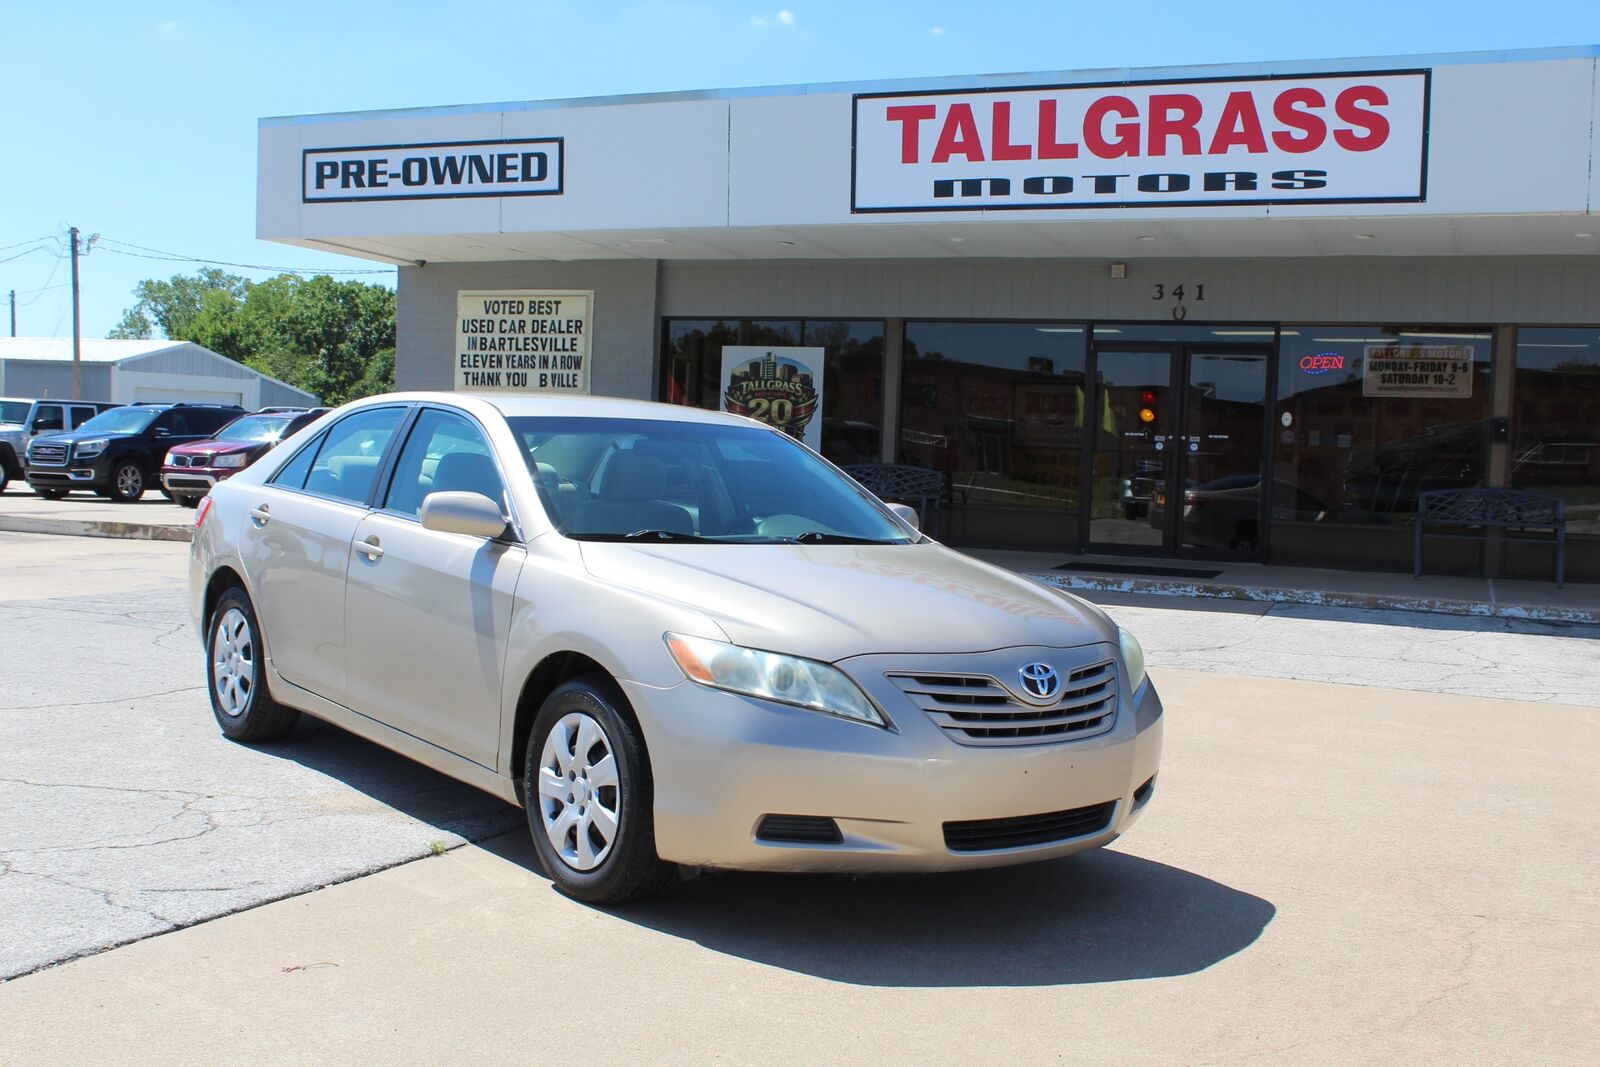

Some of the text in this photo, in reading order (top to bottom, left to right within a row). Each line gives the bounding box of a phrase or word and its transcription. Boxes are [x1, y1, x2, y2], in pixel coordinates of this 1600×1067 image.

[886, 85, 1391, 164] TALLGRASS
[315, 151, 548, 190] PRE-OWNED
[933, 169, 1327, 199] MOTORS
[1152, 283, 1205, 301] 341
[484, 300, 562, 315] VOTED BEST
[462, 319, 583, 334] USED CAR DEALER
[467, 337, 577, 352] IN BARTLESVILLE
[1371, 348, 1468, 359] TALLGRASS MOTORS
[460, 354, 583, 370] ELEVEN YEARS IN A ROW
[1300, 355, 1345, 369] OPEN
[463, 372, 502, 387] THANK
[506, 372, 528, 387] YOU
[551, 373, 578, 388] VILLE
[1381, 373, 1456, 385] SATURDAY 10-2
[740, 379, 803, 396] TALLGRASS
[747, 398, 793, 425] 20
